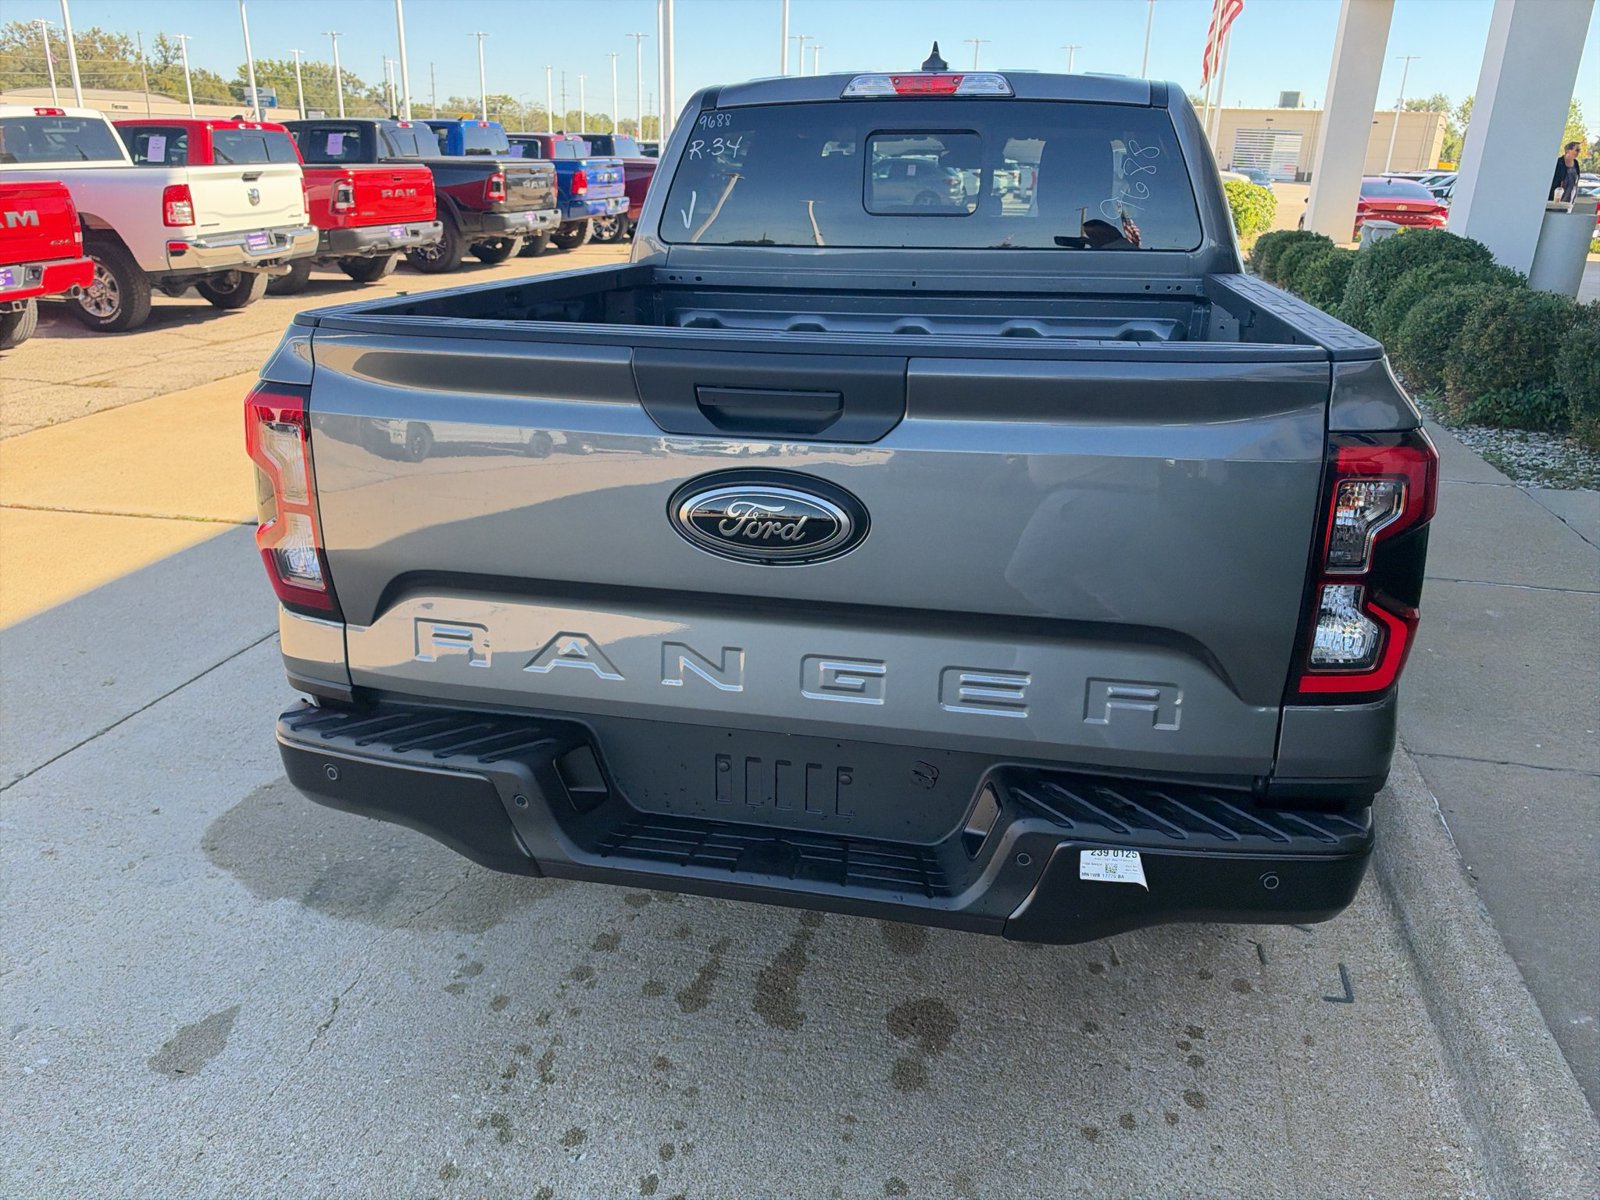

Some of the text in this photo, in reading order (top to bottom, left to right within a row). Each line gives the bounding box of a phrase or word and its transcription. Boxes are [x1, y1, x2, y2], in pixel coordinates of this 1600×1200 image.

[699, 113, 732, 131] 9688
[381, 188, 417, 198] RAM
[718, 499, 808, 542] Ford
[412, 617, 1184, 732] RANGER
